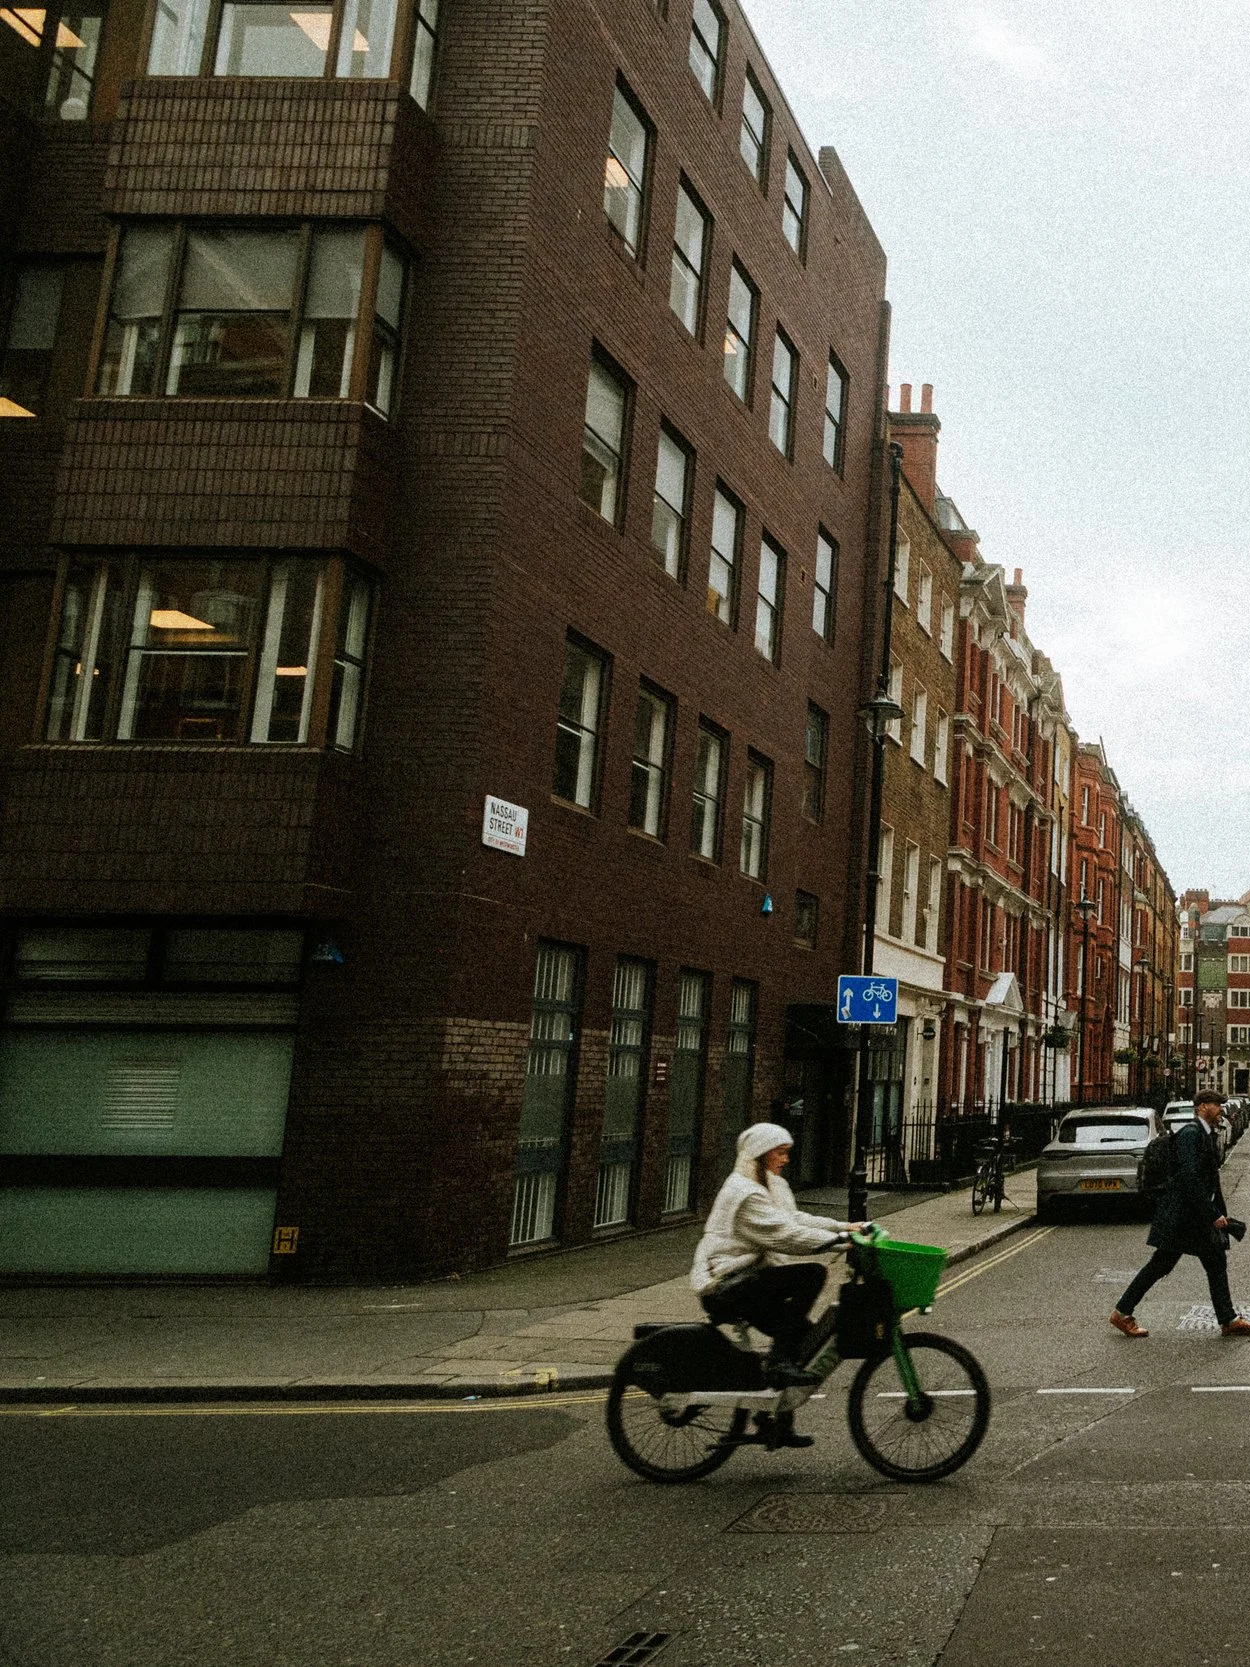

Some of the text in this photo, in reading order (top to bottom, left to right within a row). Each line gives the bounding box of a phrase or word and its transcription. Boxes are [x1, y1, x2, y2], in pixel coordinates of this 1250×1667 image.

[491, 802, 517, 822] NASSAU
[489, 817, 513, 835] STREET
[277, 1229, 295, 1251] H
